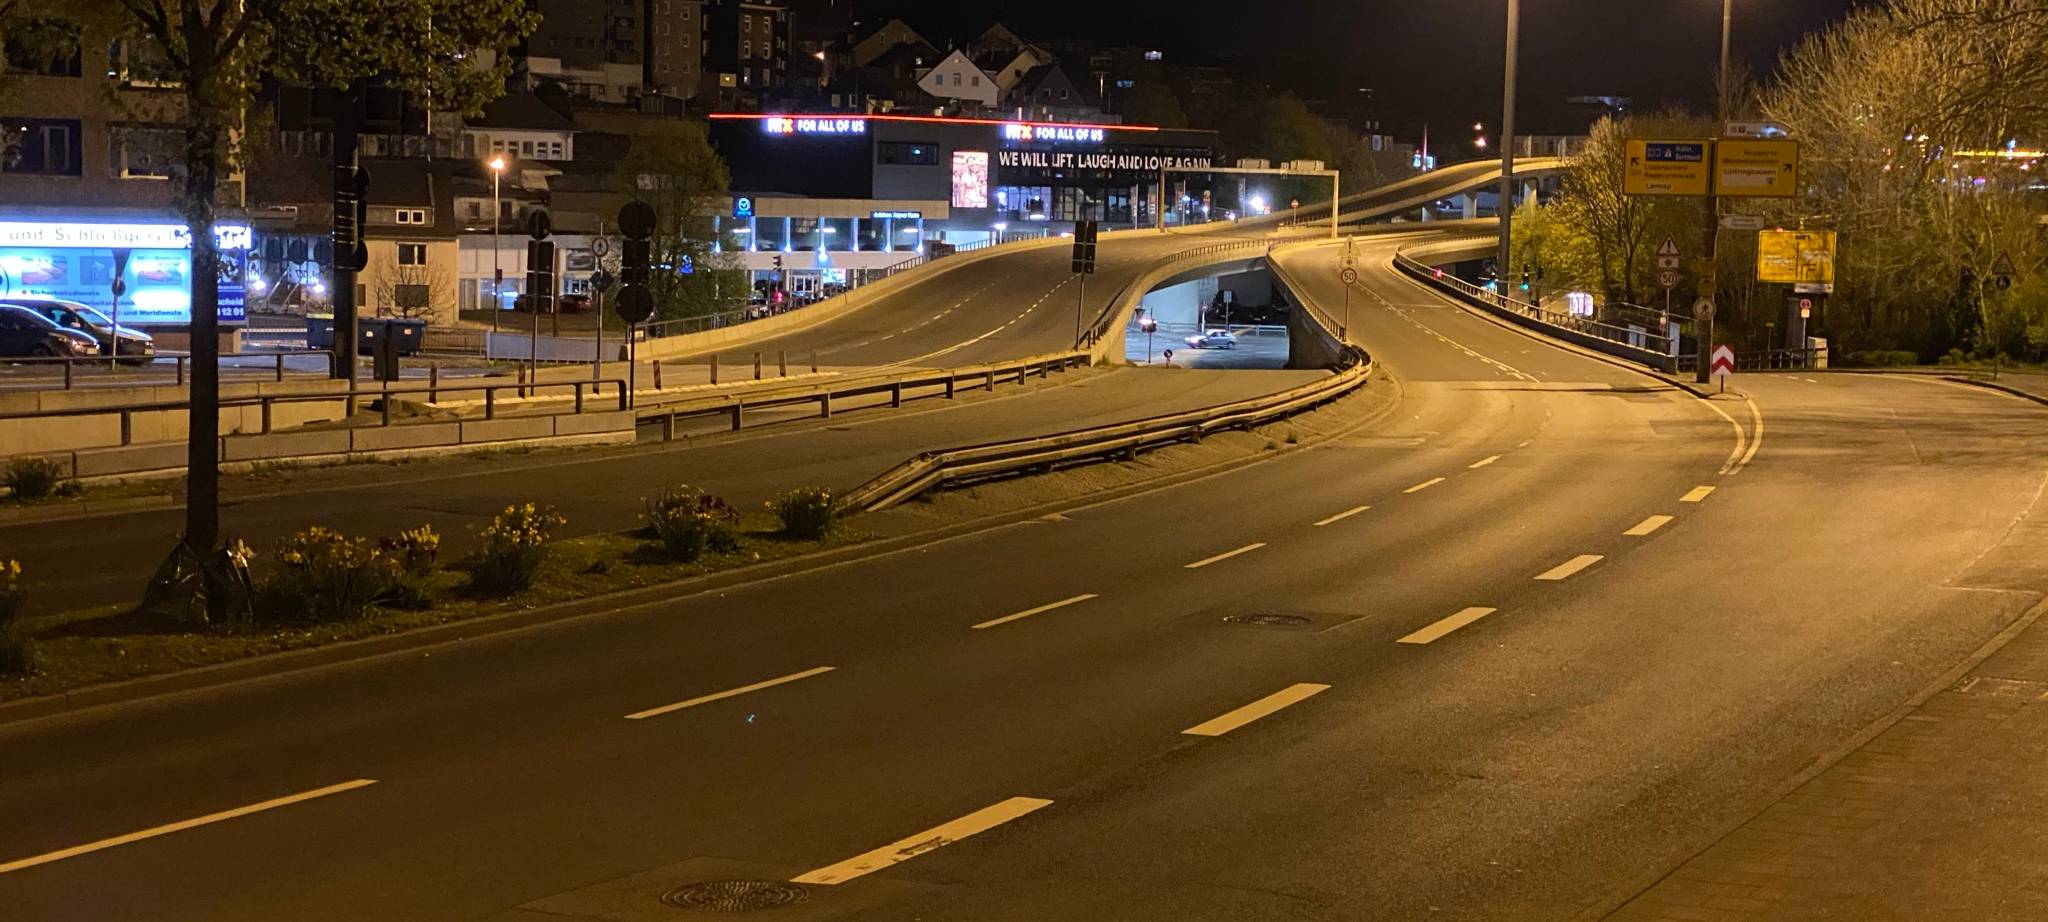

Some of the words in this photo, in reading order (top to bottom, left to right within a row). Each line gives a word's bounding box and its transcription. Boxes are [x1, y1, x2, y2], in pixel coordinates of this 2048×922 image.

[798, 119, 816, 132] FOR
[818, 119, 835, 132] ALL
[836, 119, 849, 132] OF
[851, 119, 864, 132] US
[1036, 126, 1055, 139] FOR
[1057, 128, 1074, 140] ALL
[1075, 128, 1089, 140] OF
[1090, 129, 1103, 141] US
[999, 151, 1018, 167] WE
[1020, 152, 1047, 168] WILL
[1051, 153, 1074, 169] LIFT,
[1078, 154, 1115, 169] LAUGH
[1117, 155, 1142, 170] AND
[1144, 156, 1173, 170] LOVE
[1175, 157, 1211, 169] AGAIN
[9, 227, 43, 241] und
[1344, 272, 1354, 281] 50
[1662, 274, 1675, 283] 50
